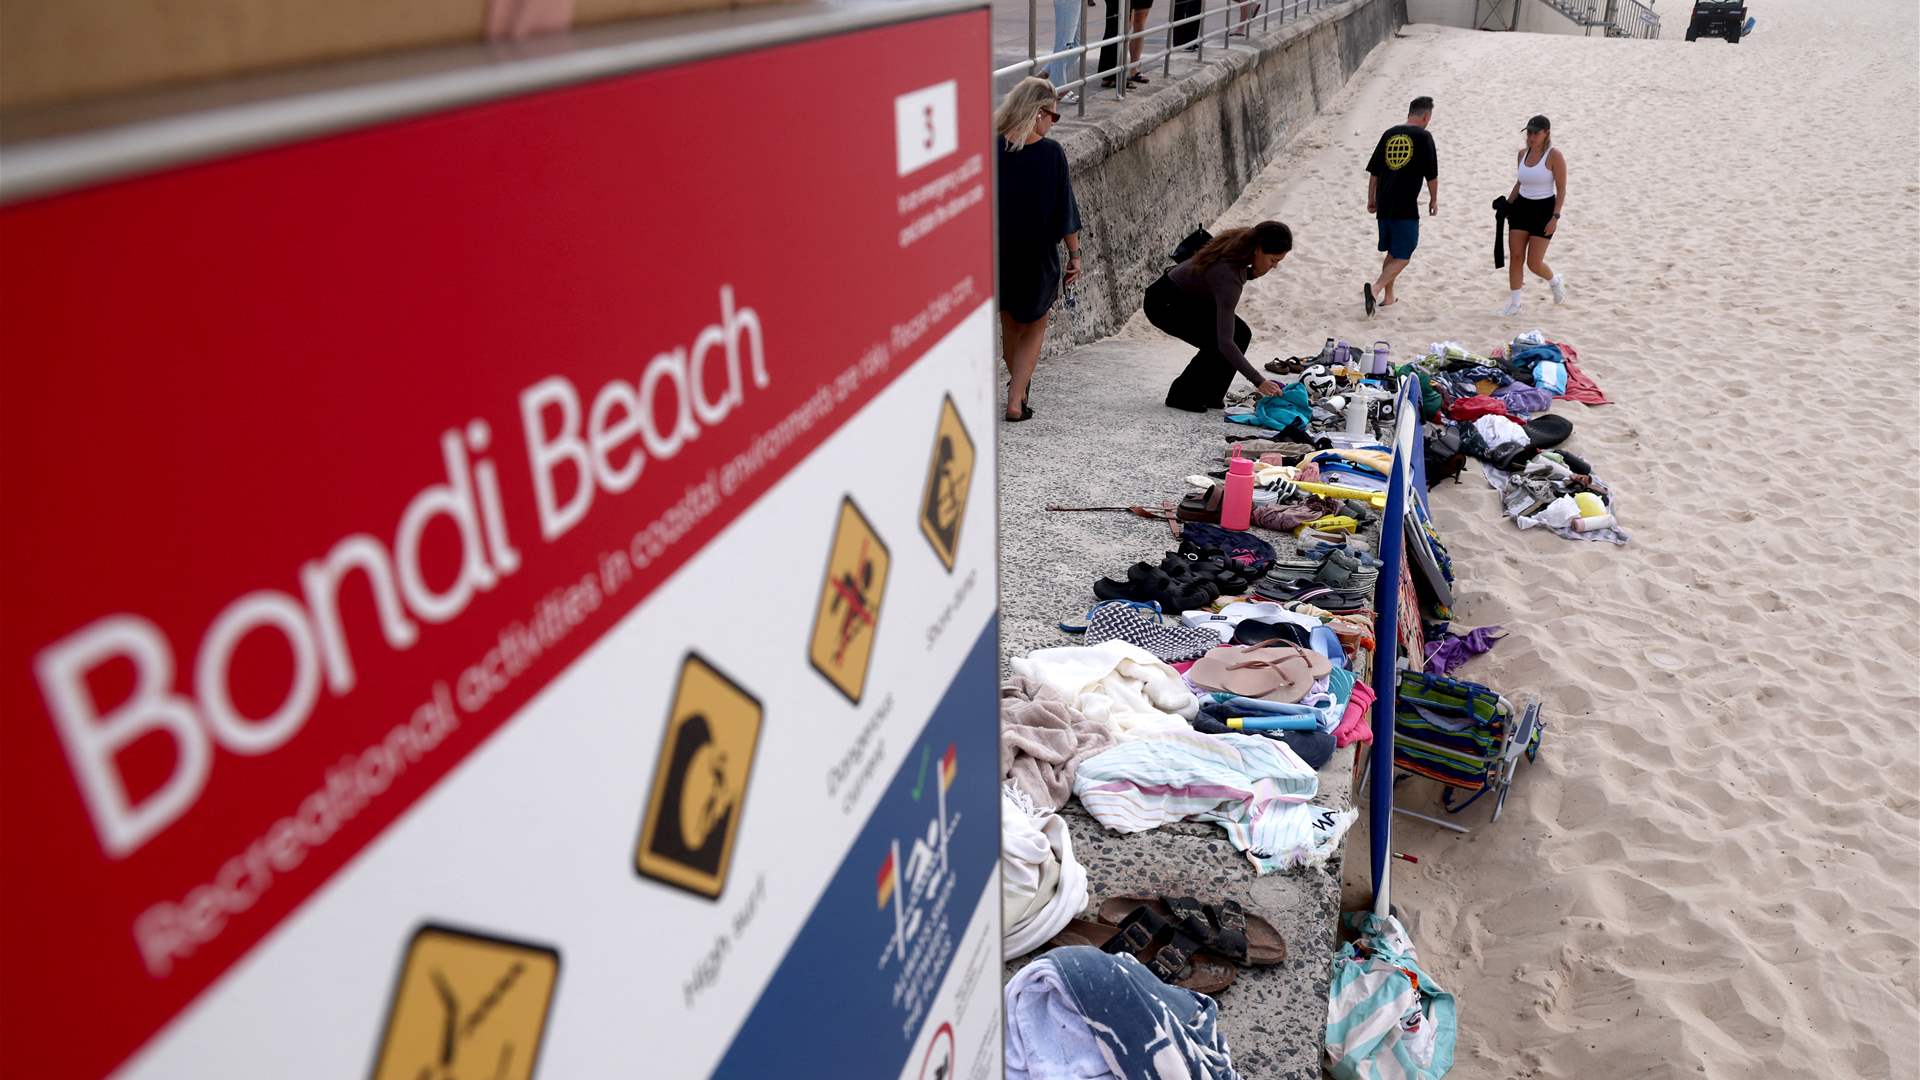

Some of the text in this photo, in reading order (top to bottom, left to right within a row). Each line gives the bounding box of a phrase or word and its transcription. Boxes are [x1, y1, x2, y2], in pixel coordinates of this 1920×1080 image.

[923, 105, 936, 150] 3
[33, 283, 769, 858] Bondi Beach
[131, 681, 459, 978] Recreational
[456, 570, 600, 713] activities
[600, 549, 632, 596] in
[630, 470, 720, 568] coastal
[719, 383, 835, 495] environments
[833, 365, 859, 403] are
[682, 936, 731, 1008] High
